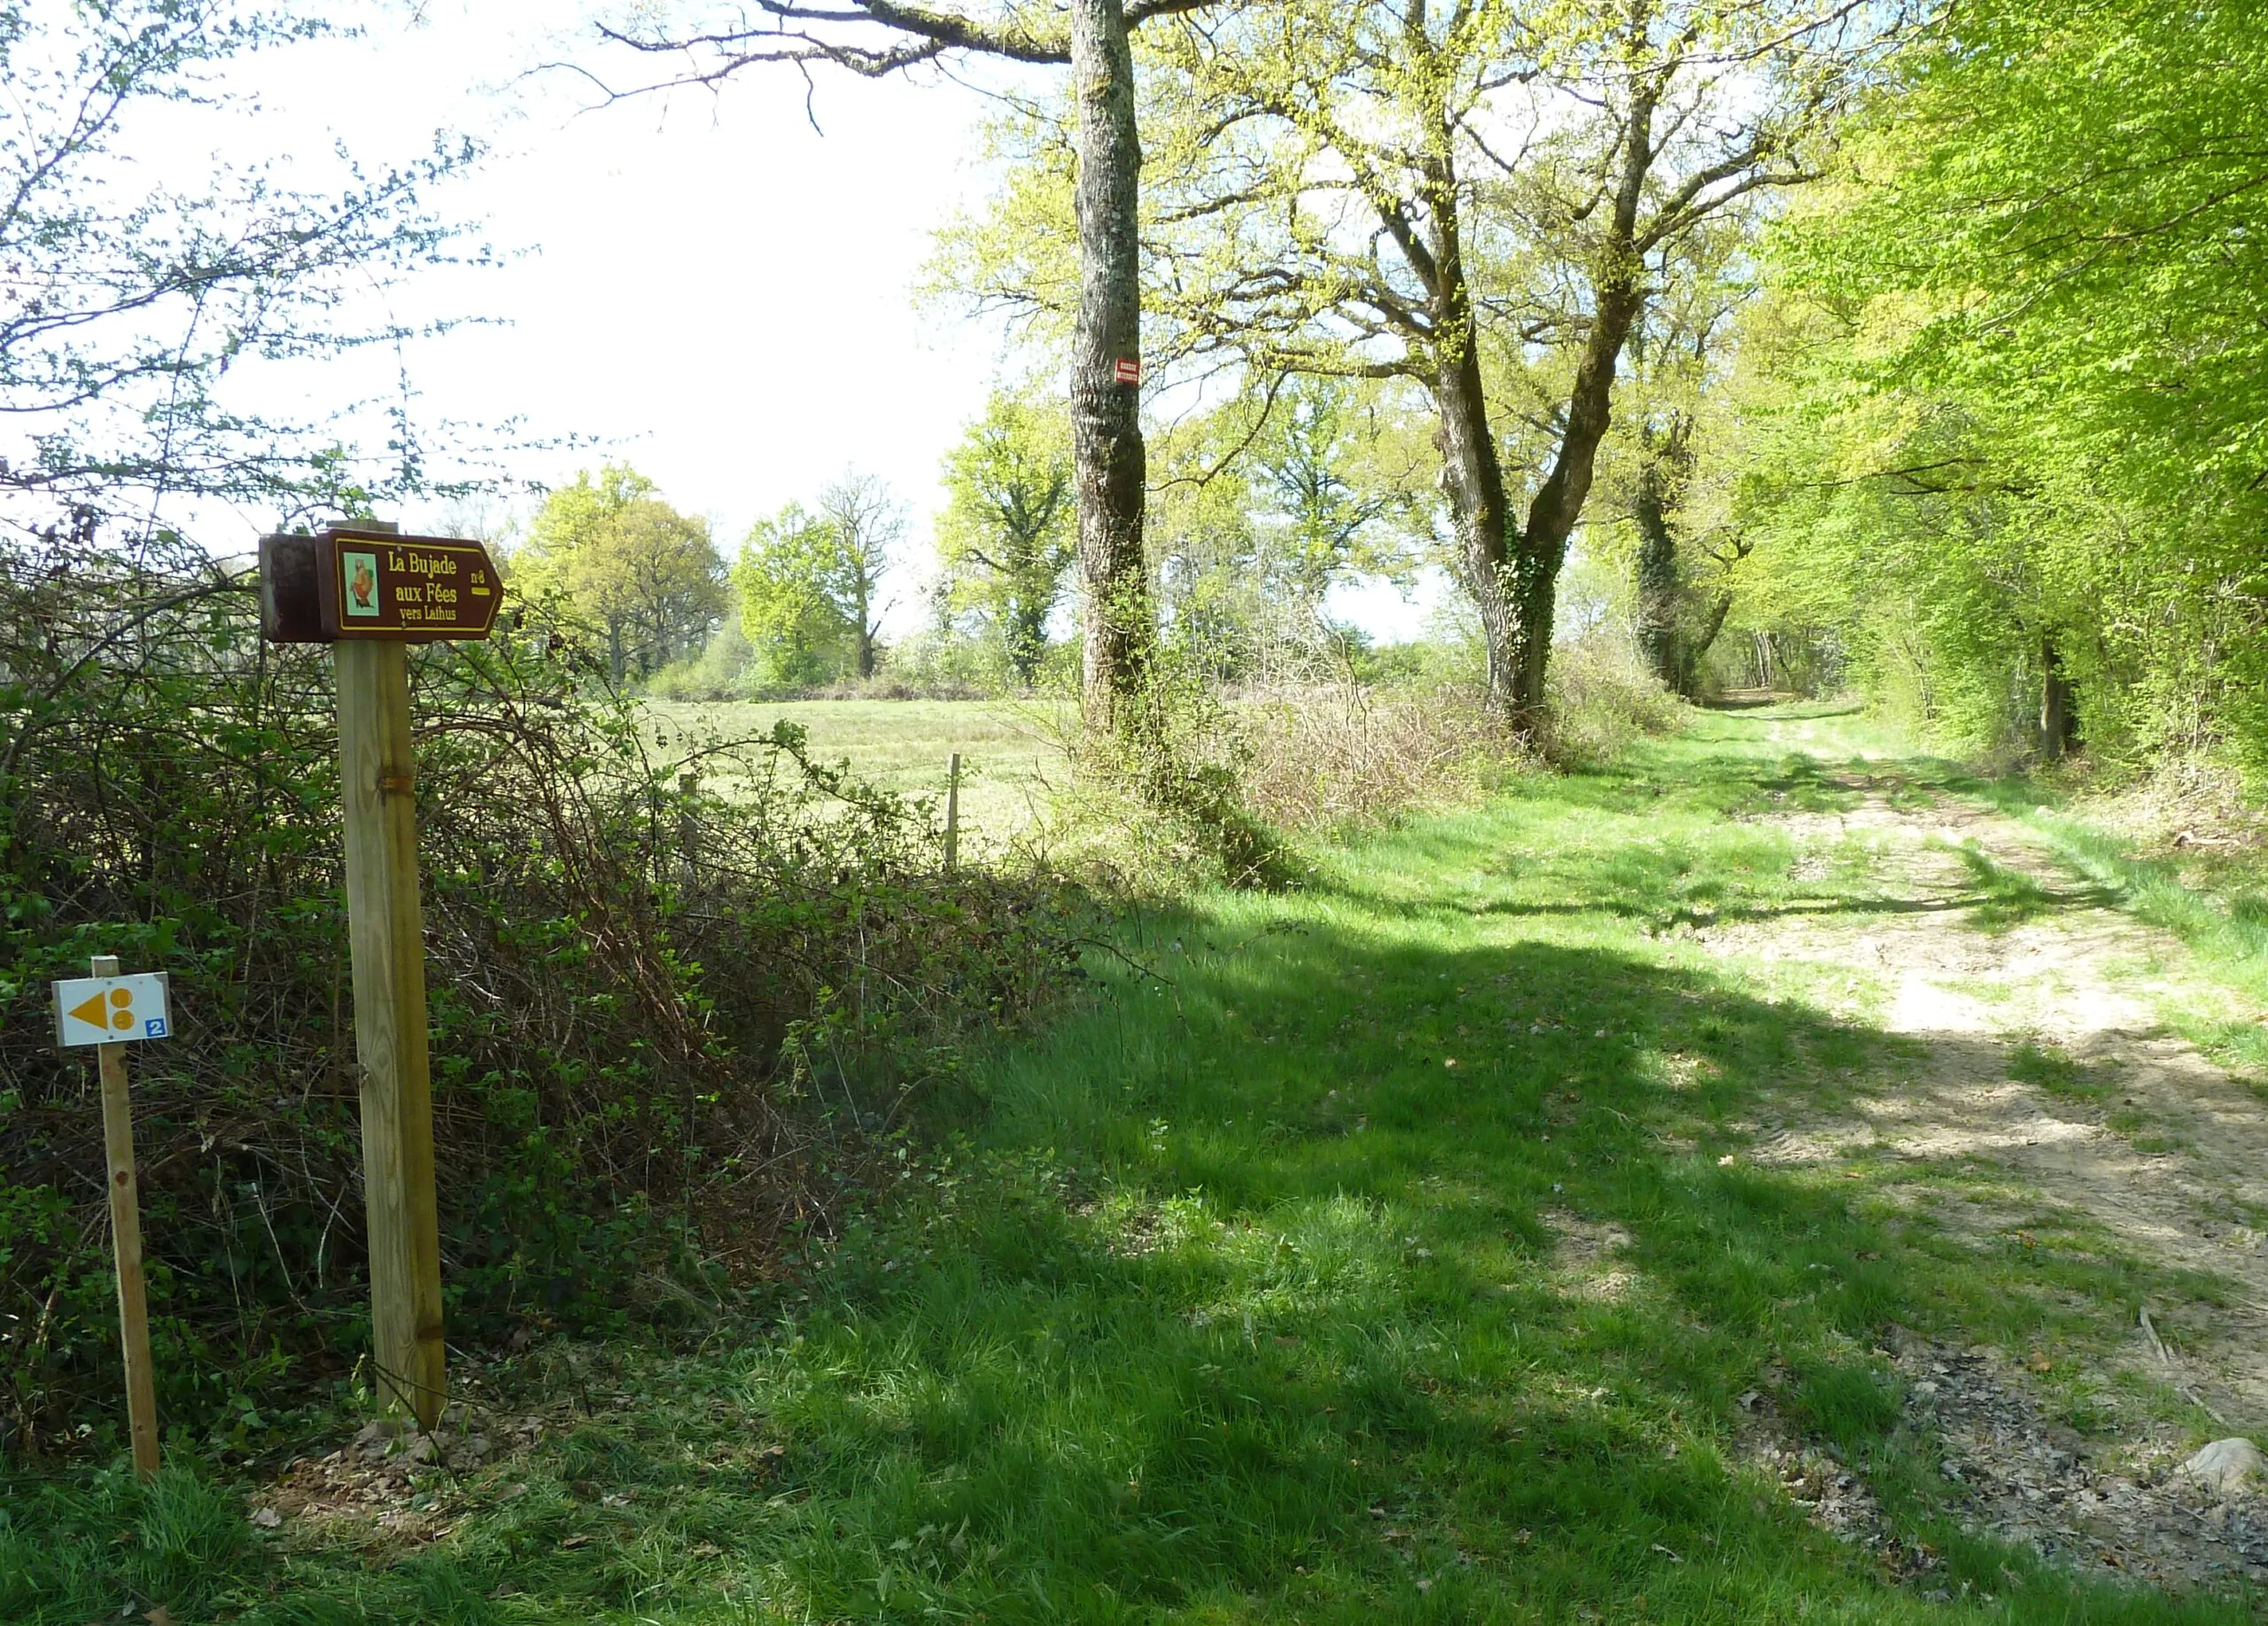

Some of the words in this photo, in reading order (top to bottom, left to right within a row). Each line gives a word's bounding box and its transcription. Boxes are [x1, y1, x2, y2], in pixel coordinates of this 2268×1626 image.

[388, 551, 405, 572] La
[408, 552, 457, 579] Bujade
[395, 587, 422, 602] aux
[425, 582, 457, 603] Fées
[400, 608, 422, 620] vers
[149, 1020, 163, 1035] 2
